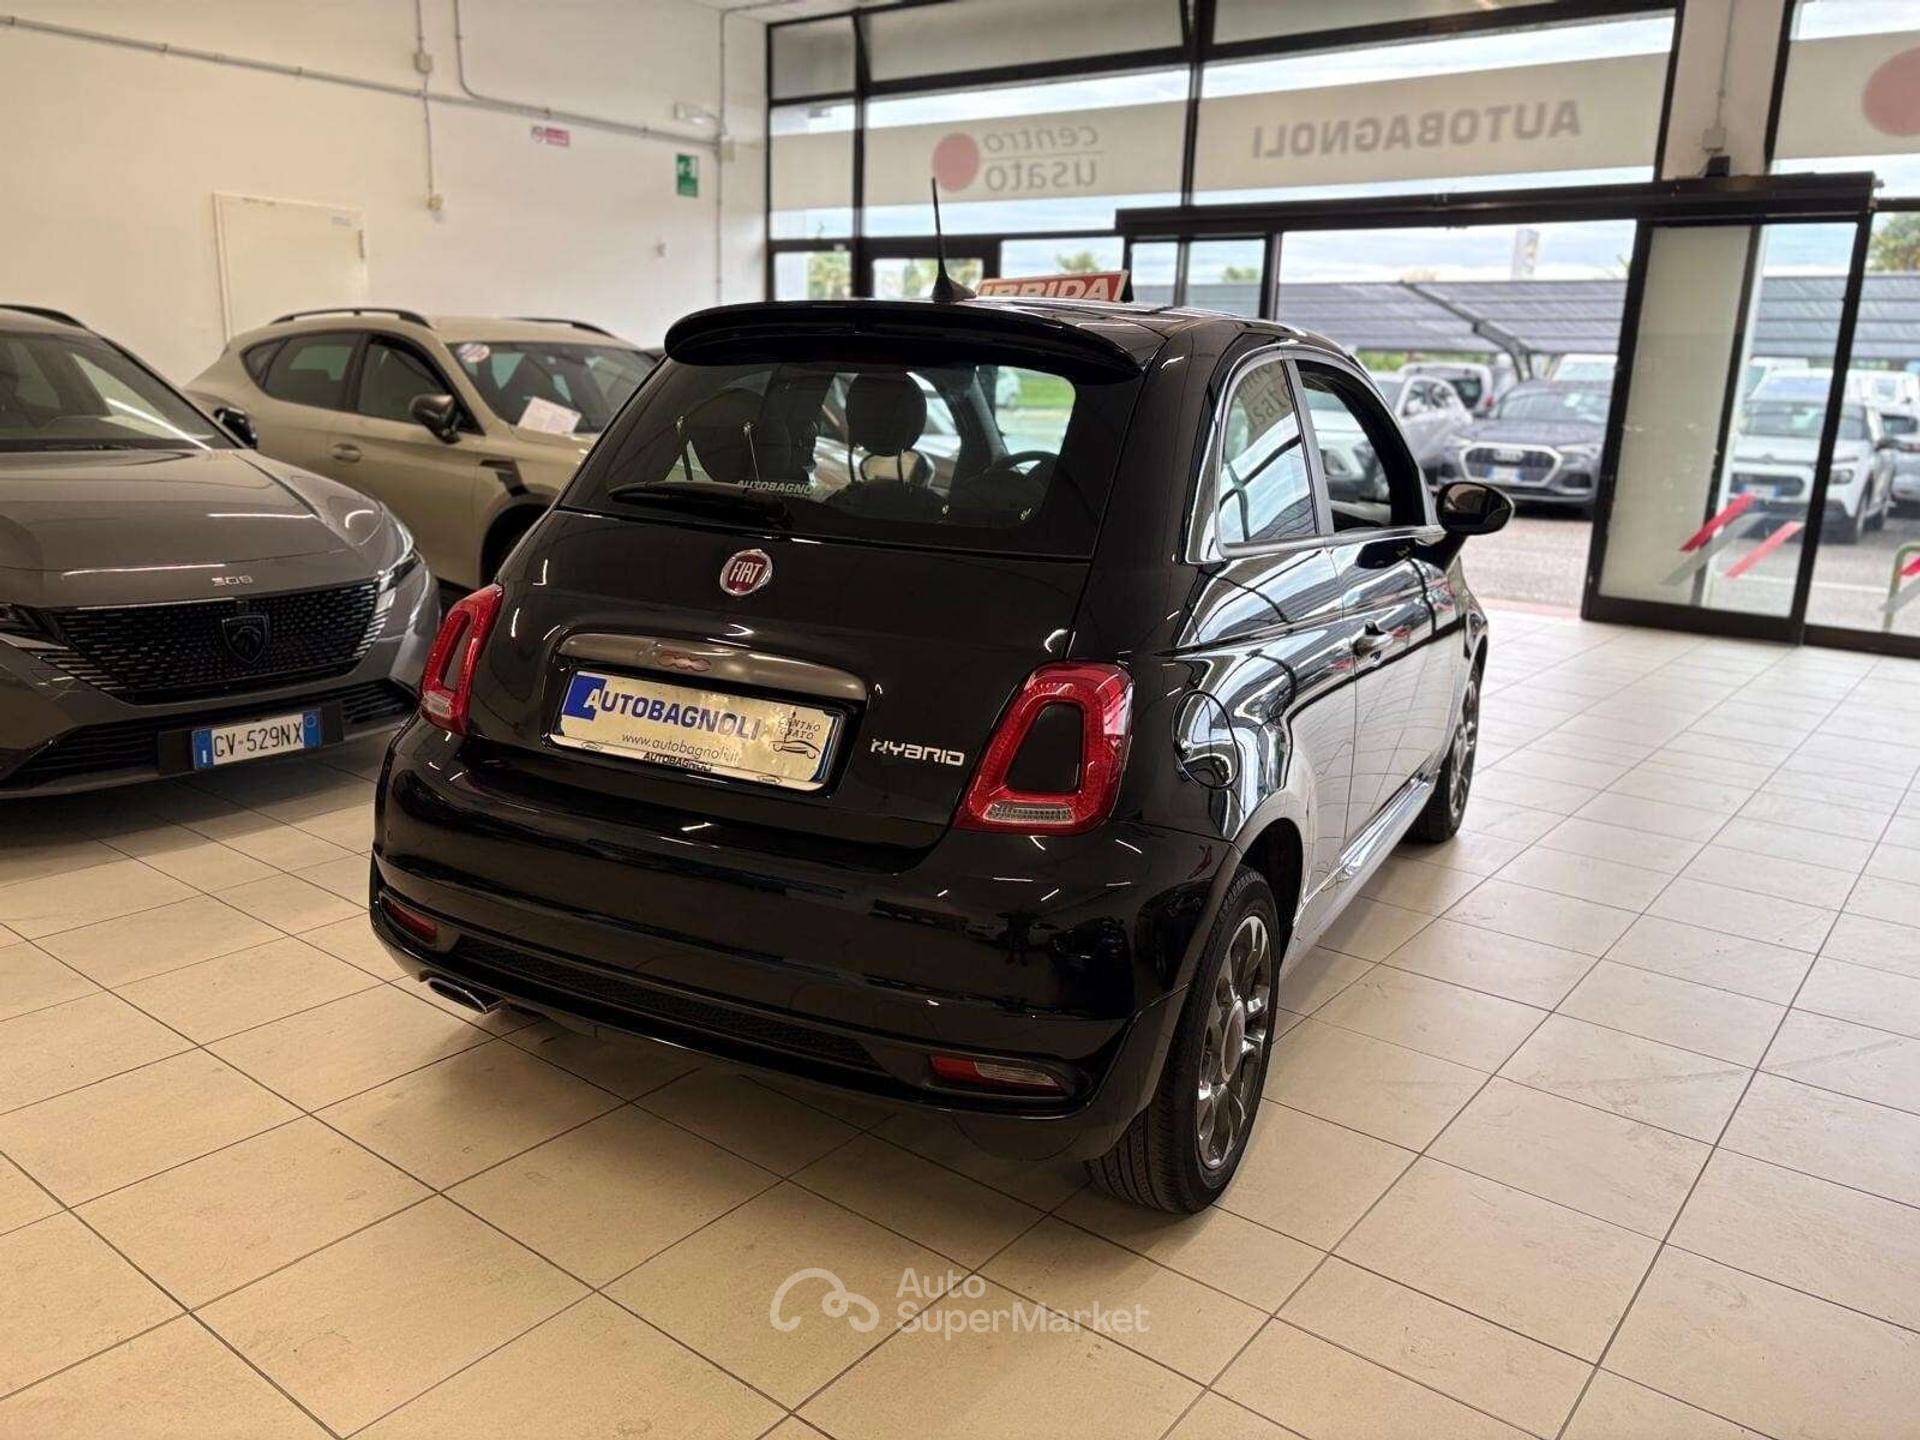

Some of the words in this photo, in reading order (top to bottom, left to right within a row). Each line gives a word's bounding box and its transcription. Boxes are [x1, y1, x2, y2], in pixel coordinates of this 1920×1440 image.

[737, 480, 817, 495] AUTOBAGNO
[729, 560, 763, 584] FIAT
[583, 688, 762, 741] AUTOBAGNOLI
[870, 739, 965, 766] HYBRID
